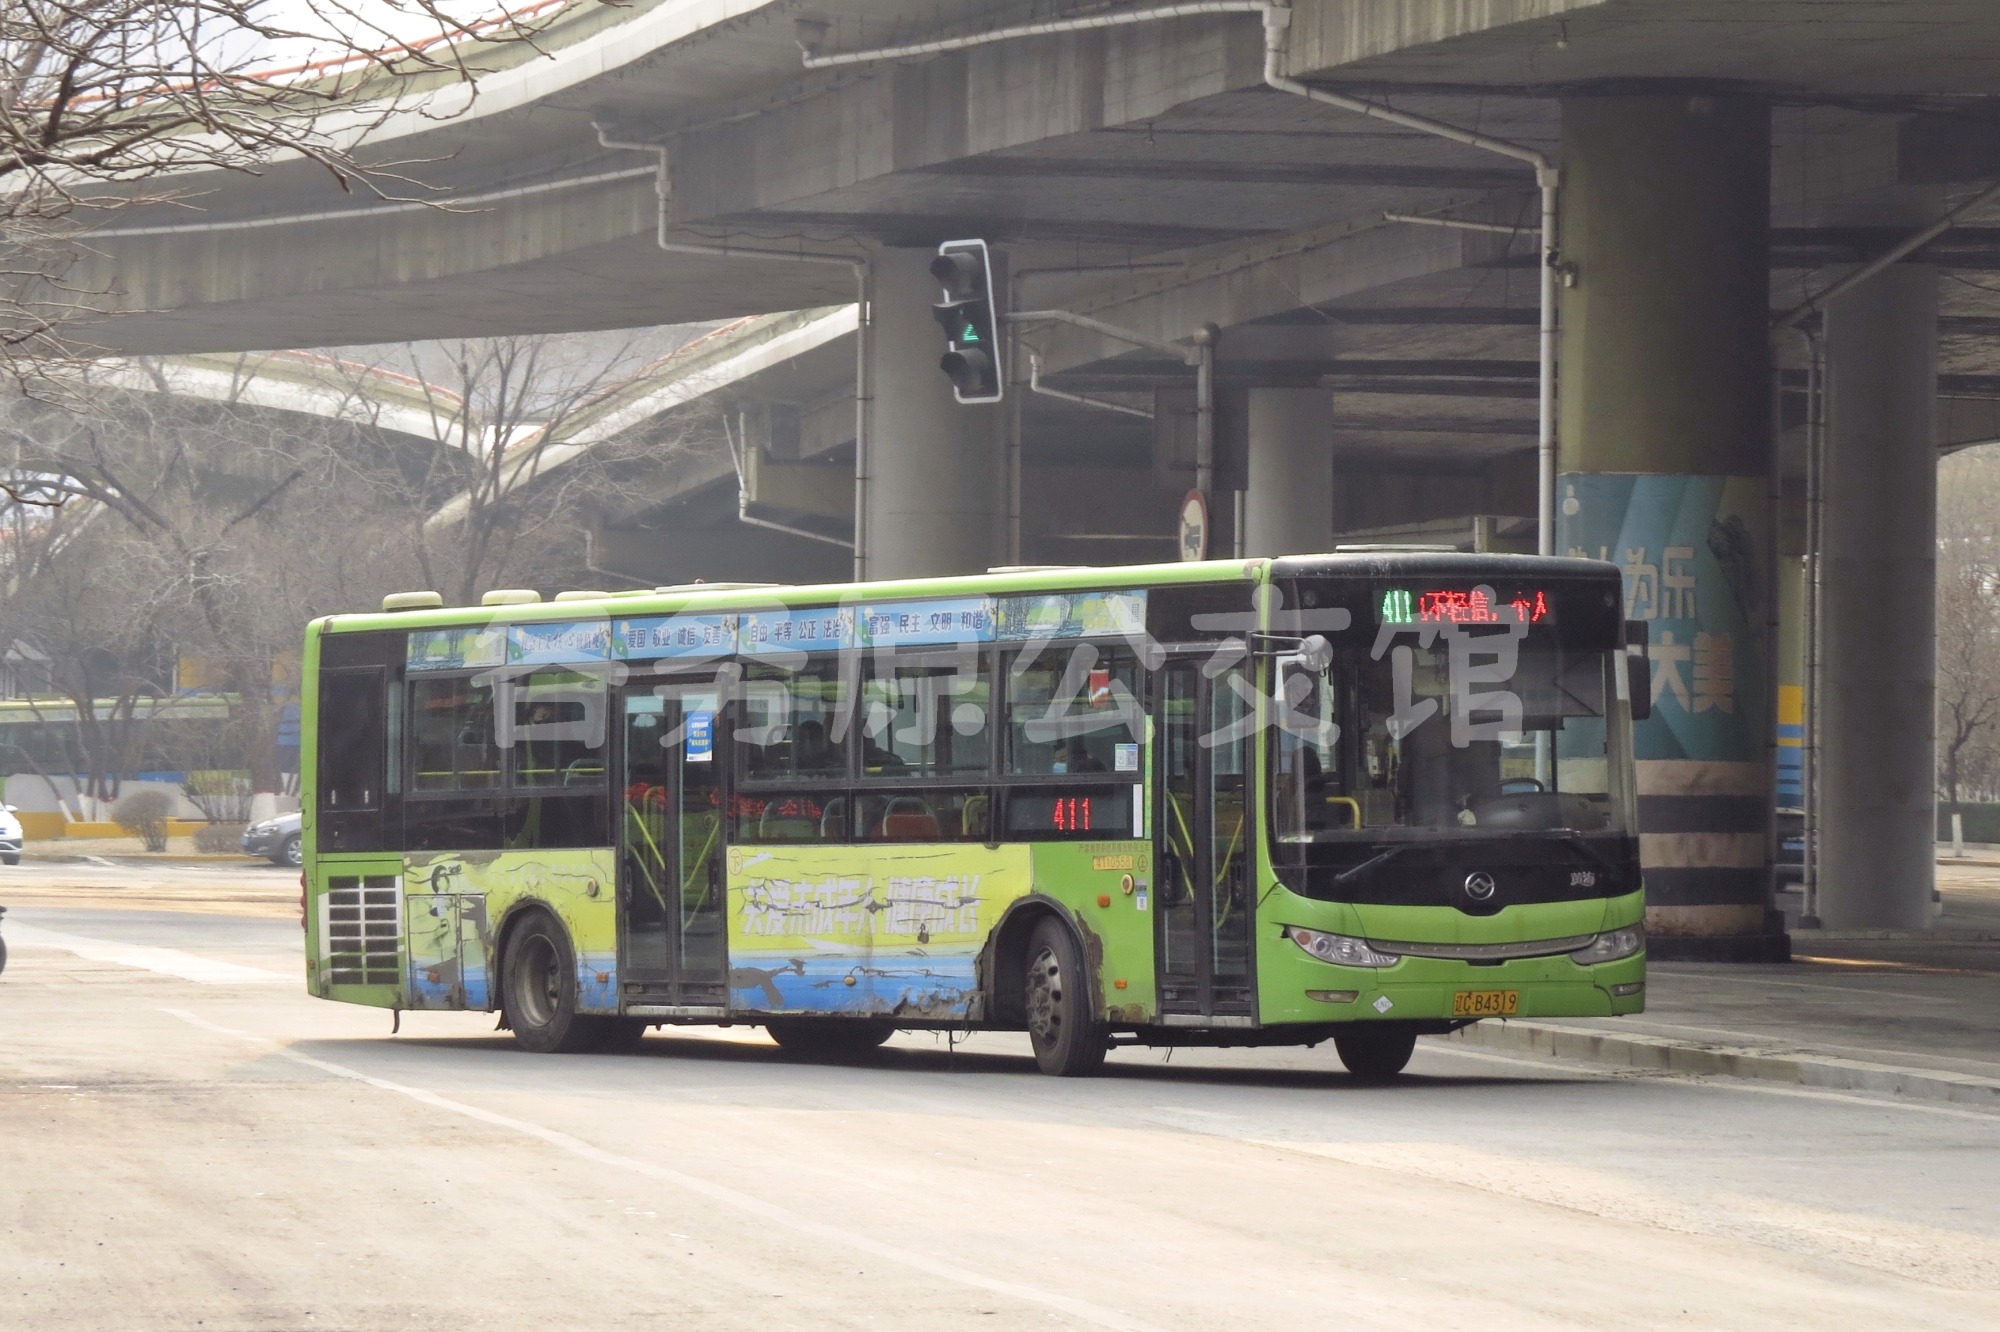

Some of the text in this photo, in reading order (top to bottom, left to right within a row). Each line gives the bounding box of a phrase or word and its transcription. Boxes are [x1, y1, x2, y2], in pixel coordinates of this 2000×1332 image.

[1382, 590, 1412, 623] 411
[627, 624, 723, 649] 爱国 敬业 诚信 友善
[750, 618, 842, 643] 自由 平等 公正 法治
[868, 610, 984, 636] 富强 民主 文明 和谐
[1053, 798, 1090, 830] 411
[742, 874, 981, 935] 关爱未成年人 健康成长
